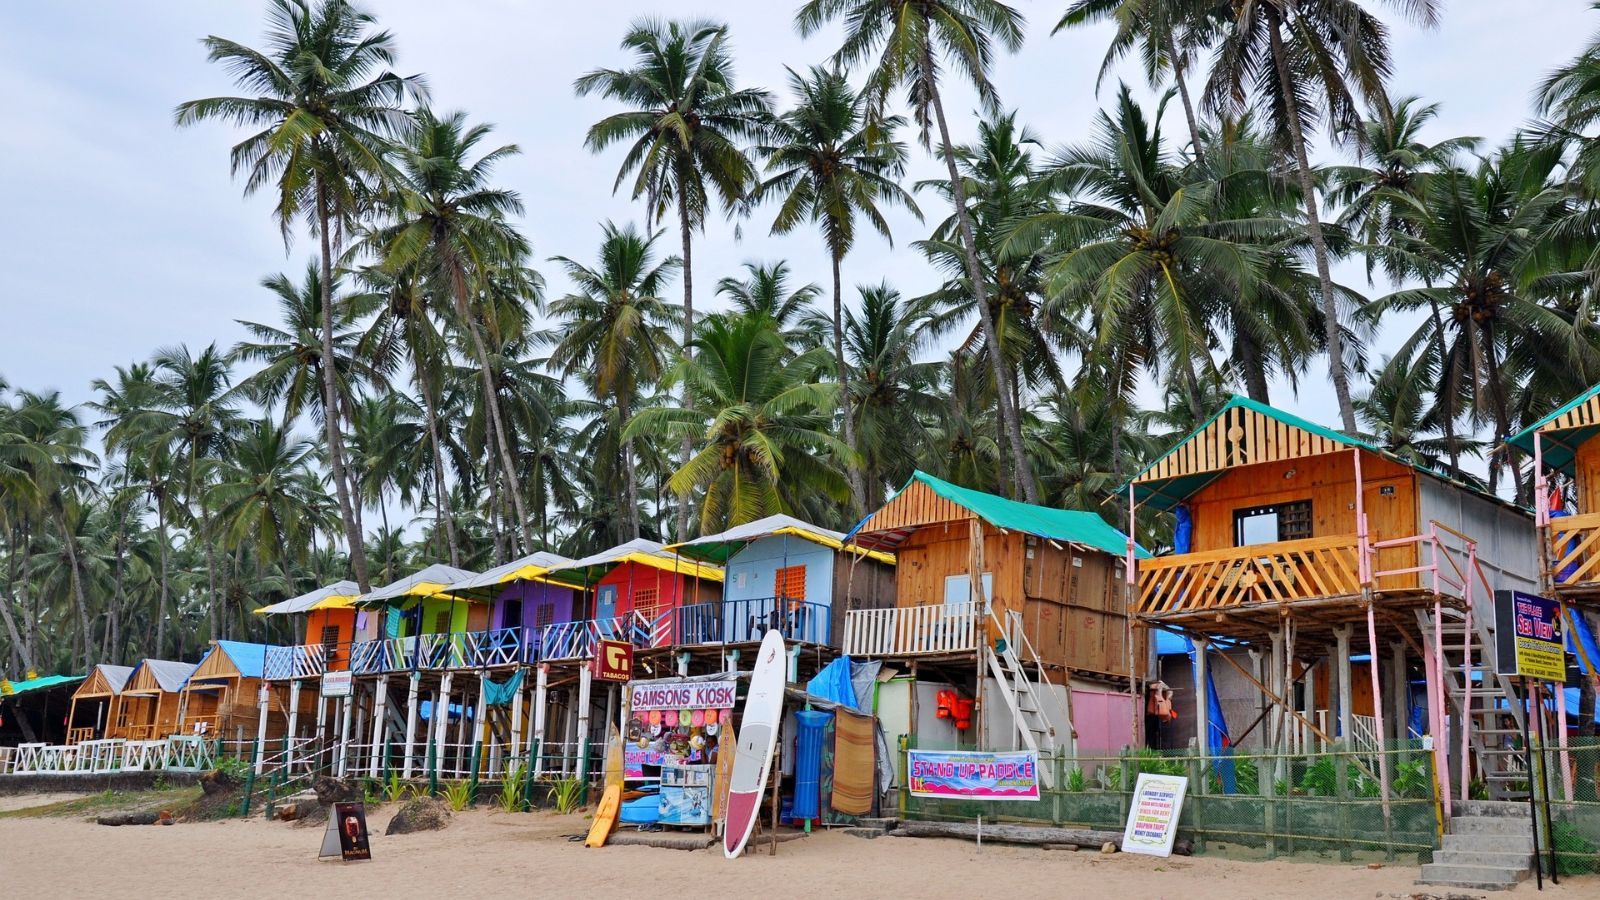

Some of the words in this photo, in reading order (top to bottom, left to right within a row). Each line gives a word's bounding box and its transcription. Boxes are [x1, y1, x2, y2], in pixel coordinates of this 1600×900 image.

[1517, 601, 1528, 614] THE
[1528, 603, 1542, 617] PLACE
[603, 672, 630, 681] TABACOS
[633, 689, 691, 706] SAMSONS
[697, 687, 735, 705] KIOSK
[913, 761, 954, 778] STAND
[958, 762, 976, 779] UP
[979, 762, 1034, 780] PADDLE
[1153, 823, 1165, 831] TRIPS
